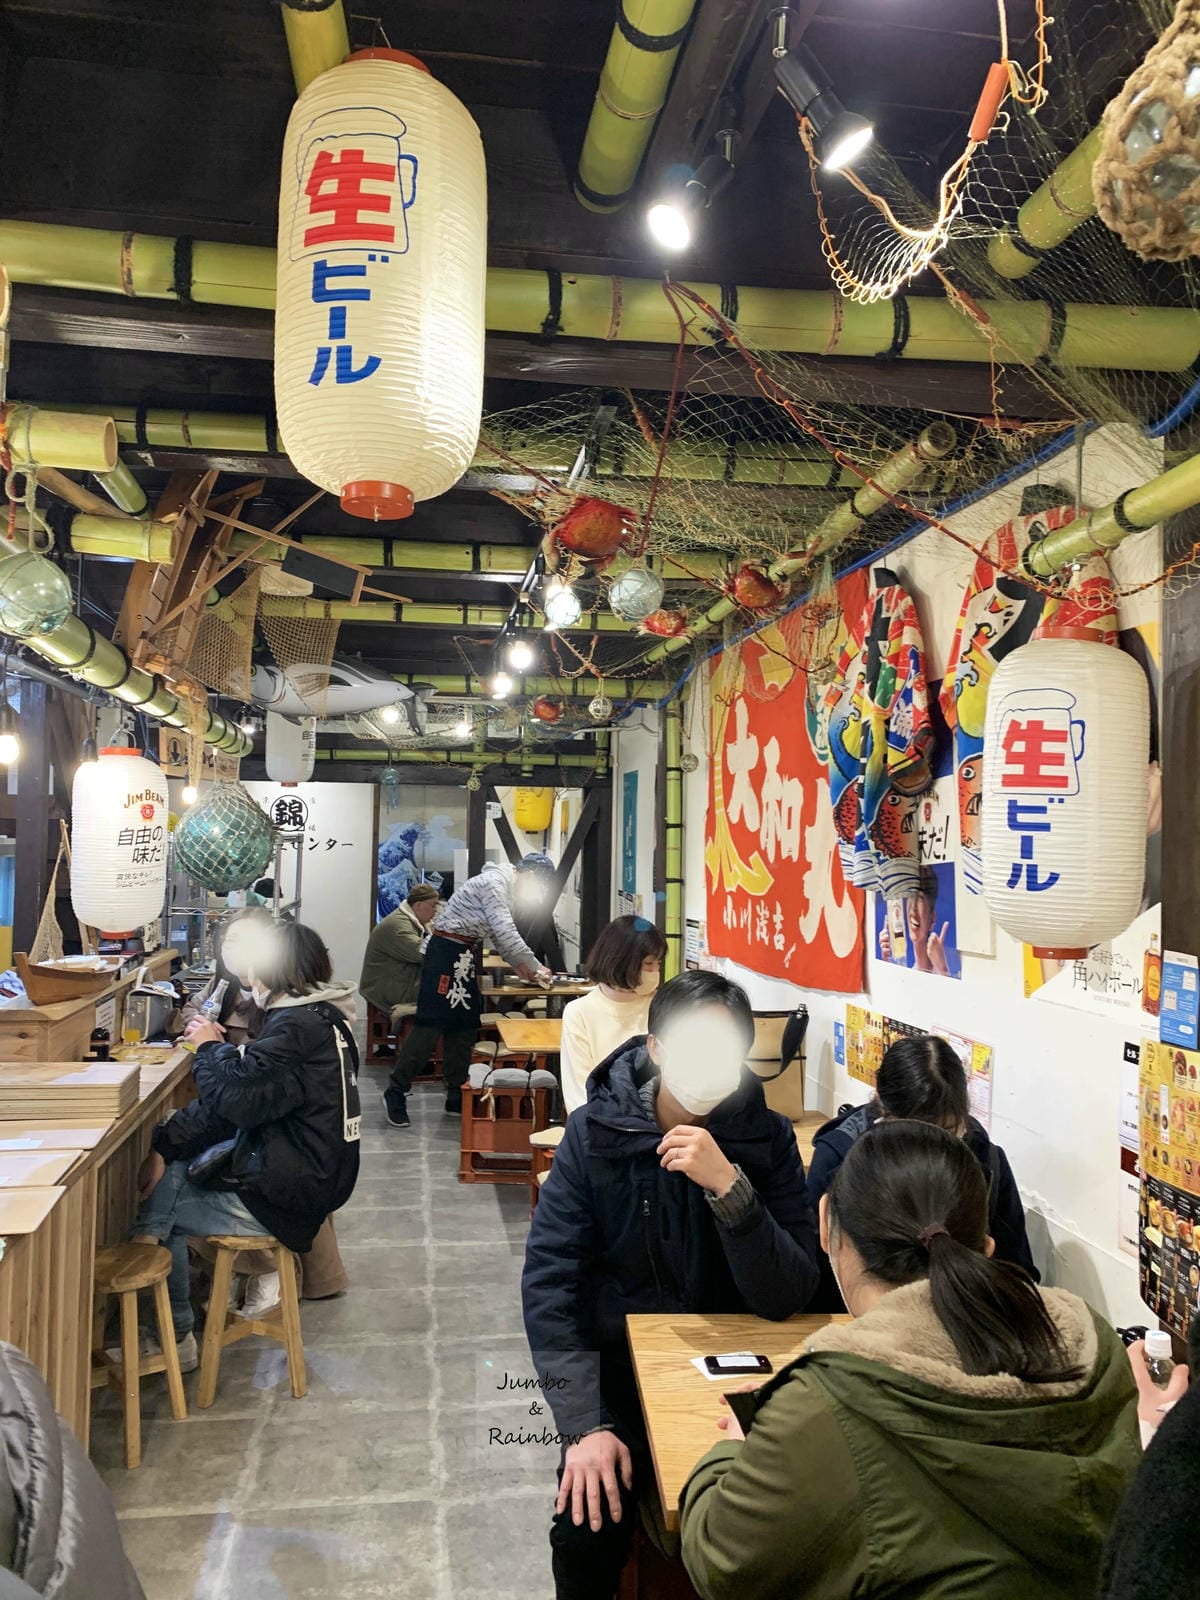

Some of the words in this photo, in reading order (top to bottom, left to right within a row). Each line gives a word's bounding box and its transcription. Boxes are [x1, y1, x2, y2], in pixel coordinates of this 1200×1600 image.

[304, 149, 397, 388] 生ビール
[123, 793, 144, 809] JIM
[274, 798, 305, 828] 錦
[1001, 719, 1069, 892] 生ビール
[118, 825, 164, 846] 自由の
[445, 948, 474, 1010] 豪快
[1073, 959, 1145, 994] 角ハイボール
